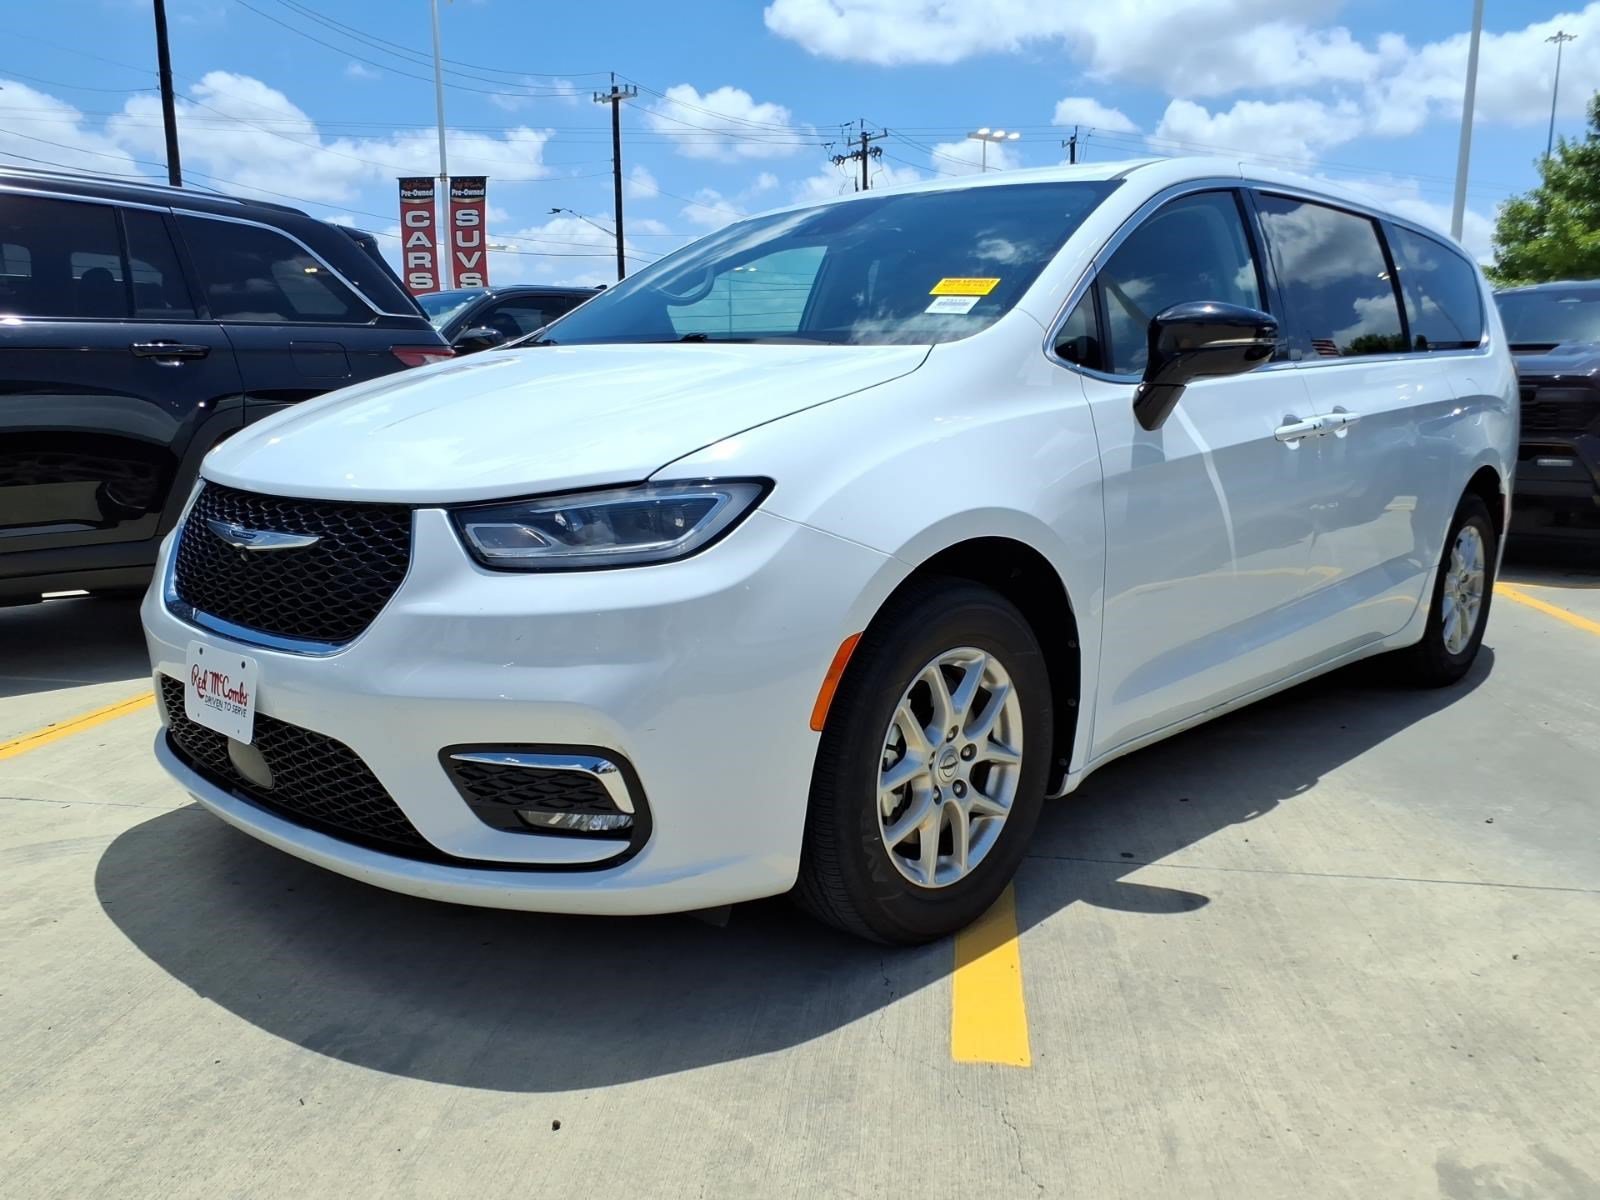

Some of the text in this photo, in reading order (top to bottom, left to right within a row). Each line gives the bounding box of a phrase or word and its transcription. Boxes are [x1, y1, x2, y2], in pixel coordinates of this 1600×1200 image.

[401, 189, 434, 197] Pre-Owned
[451, 188, 485, 196] Pre-Owned
[405, 210, 434, 289] CARS
[455, 209, 483, 289] SUVS
[191, 663, 249, 707] Red McCombs
[204, 694, 248, 718] DRIVEN TO SERVE
